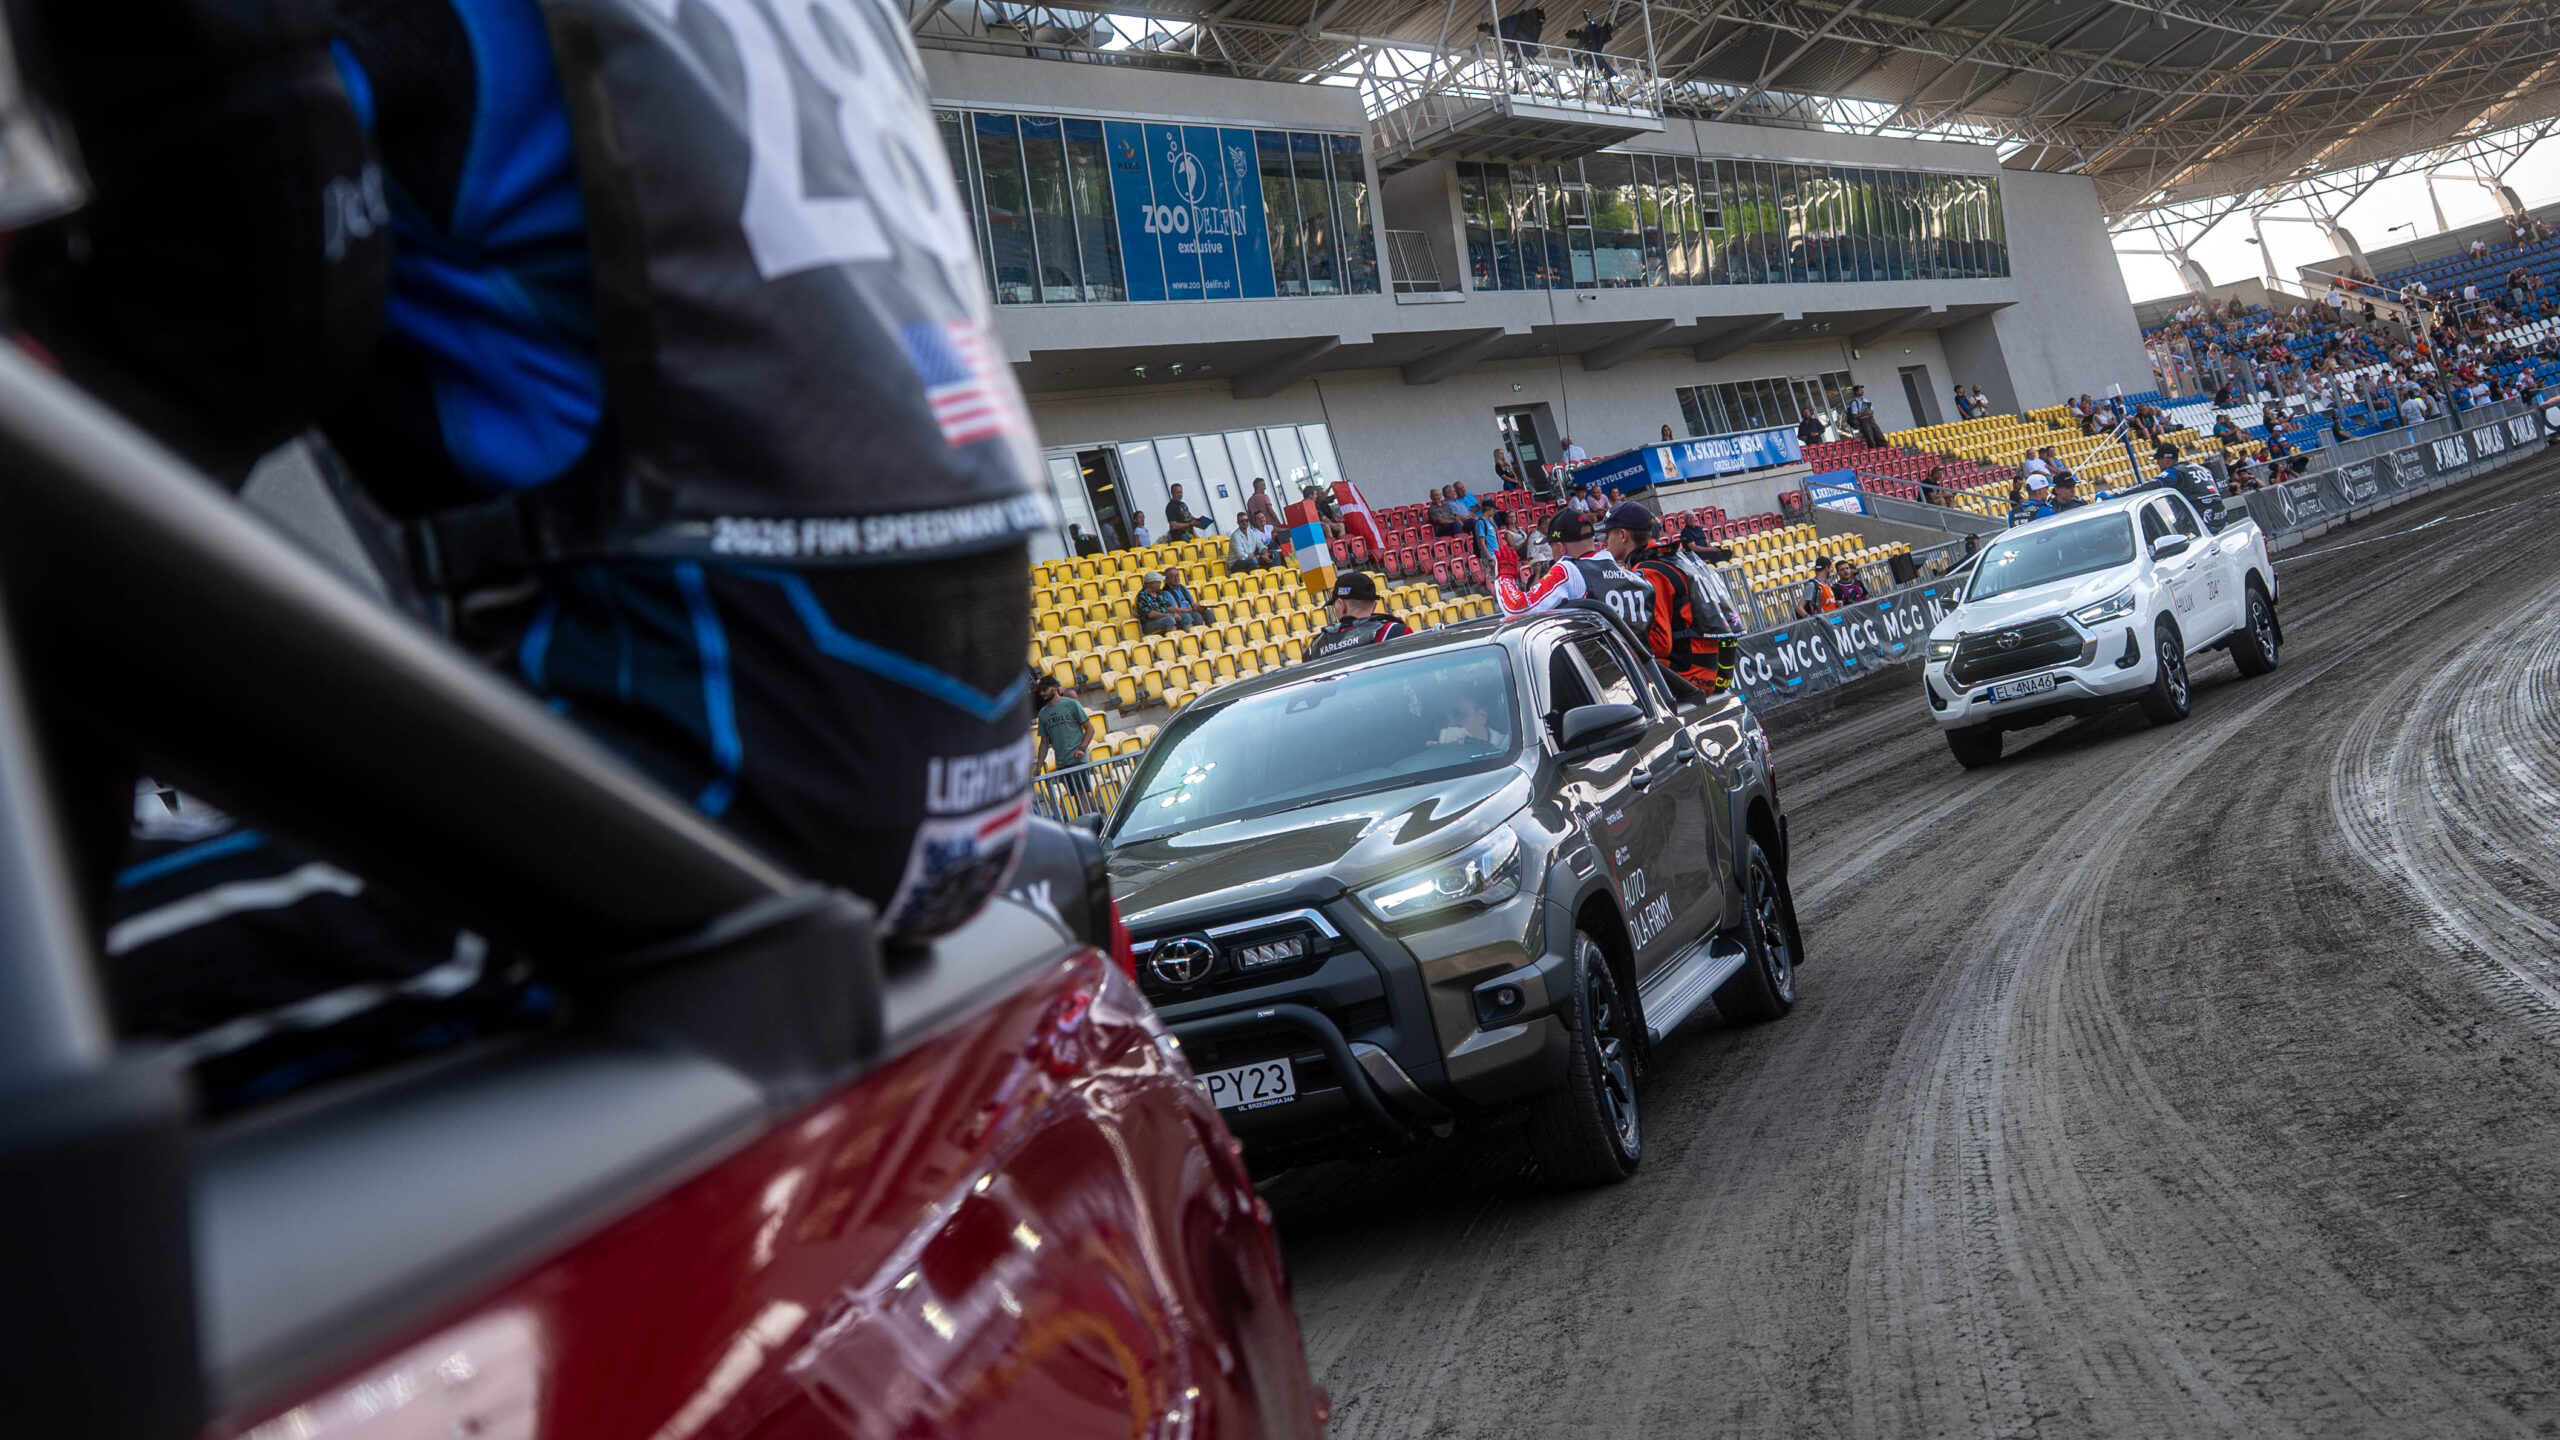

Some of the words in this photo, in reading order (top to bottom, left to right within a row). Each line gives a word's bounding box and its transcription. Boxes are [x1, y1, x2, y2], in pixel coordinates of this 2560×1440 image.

[1142, 204, 1190, 235] ZOO
[1193, 204, 1248, 237] DELFIN
[1178, 239, 1223, 254] exclusive
[1172, 279, 1231, 291] www.zoodelfin.pl
[1697, 434, 1764, 459] SKRZYDLEWSKA
[1586, 464, 1645, 490] SKRZYDLEWSKA
[802, 516, 859, 555] FIM
[861, 504, 1007, 551] SPEEDWAY
[1605, 590, 1647, 622] 911
[1320, 636, 1359, 657] KARLSSON
[1996, 686, 2011, 699] EL
[2016, 675, 2052, 695] 4NA46
[1622, 868, 1646, 911] AUTO
[1629, 912, 1648, 951] DLA
[1645, 891, 1674, 939] FIRMY
